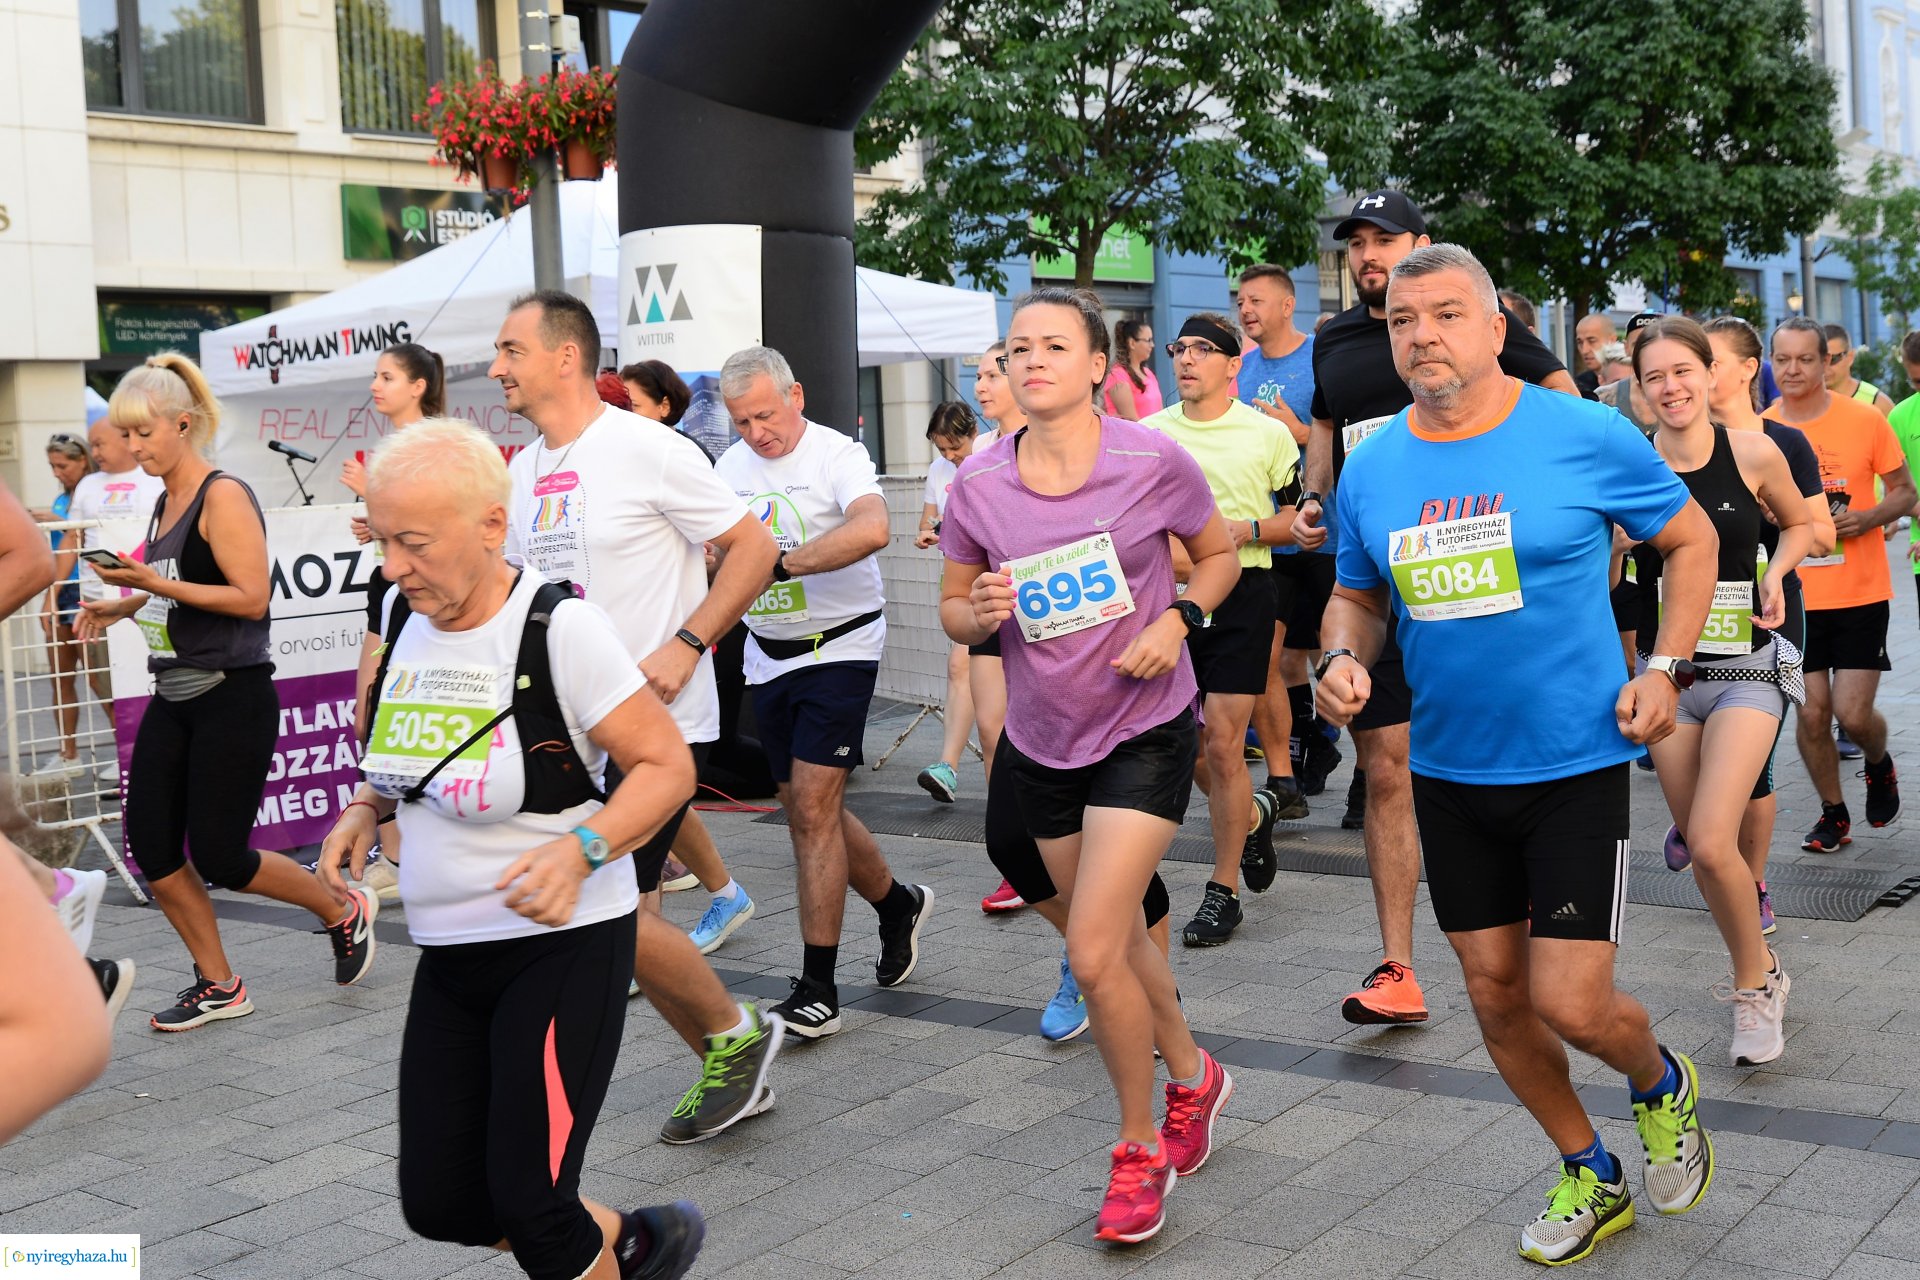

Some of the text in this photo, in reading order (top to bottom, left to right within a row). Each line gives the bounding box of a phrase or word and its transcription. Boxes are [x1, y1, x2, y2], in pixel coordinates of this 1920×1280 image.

[115, 331, 137, 341] LED
[233, 320, 412, 371] WATCHMAN TIMING
[637, 332, 674, 346] WITTUR
[259, 408, 336, 440] REAL
[1418, 492, 1504, 526] RUN
[1042, 556, 1054, 569] Te
[1056, 553, 1065, 564] is
[1066, 543, 1089, 561] zöld!
[1018, 559, 1116, 620] 695
[1410, 557, 1499, 600] 5084
[280, 631, 336, 655] orvosi
[385, 711, 474, 752] 5053
[253, 784, 328, 828] MÉG
